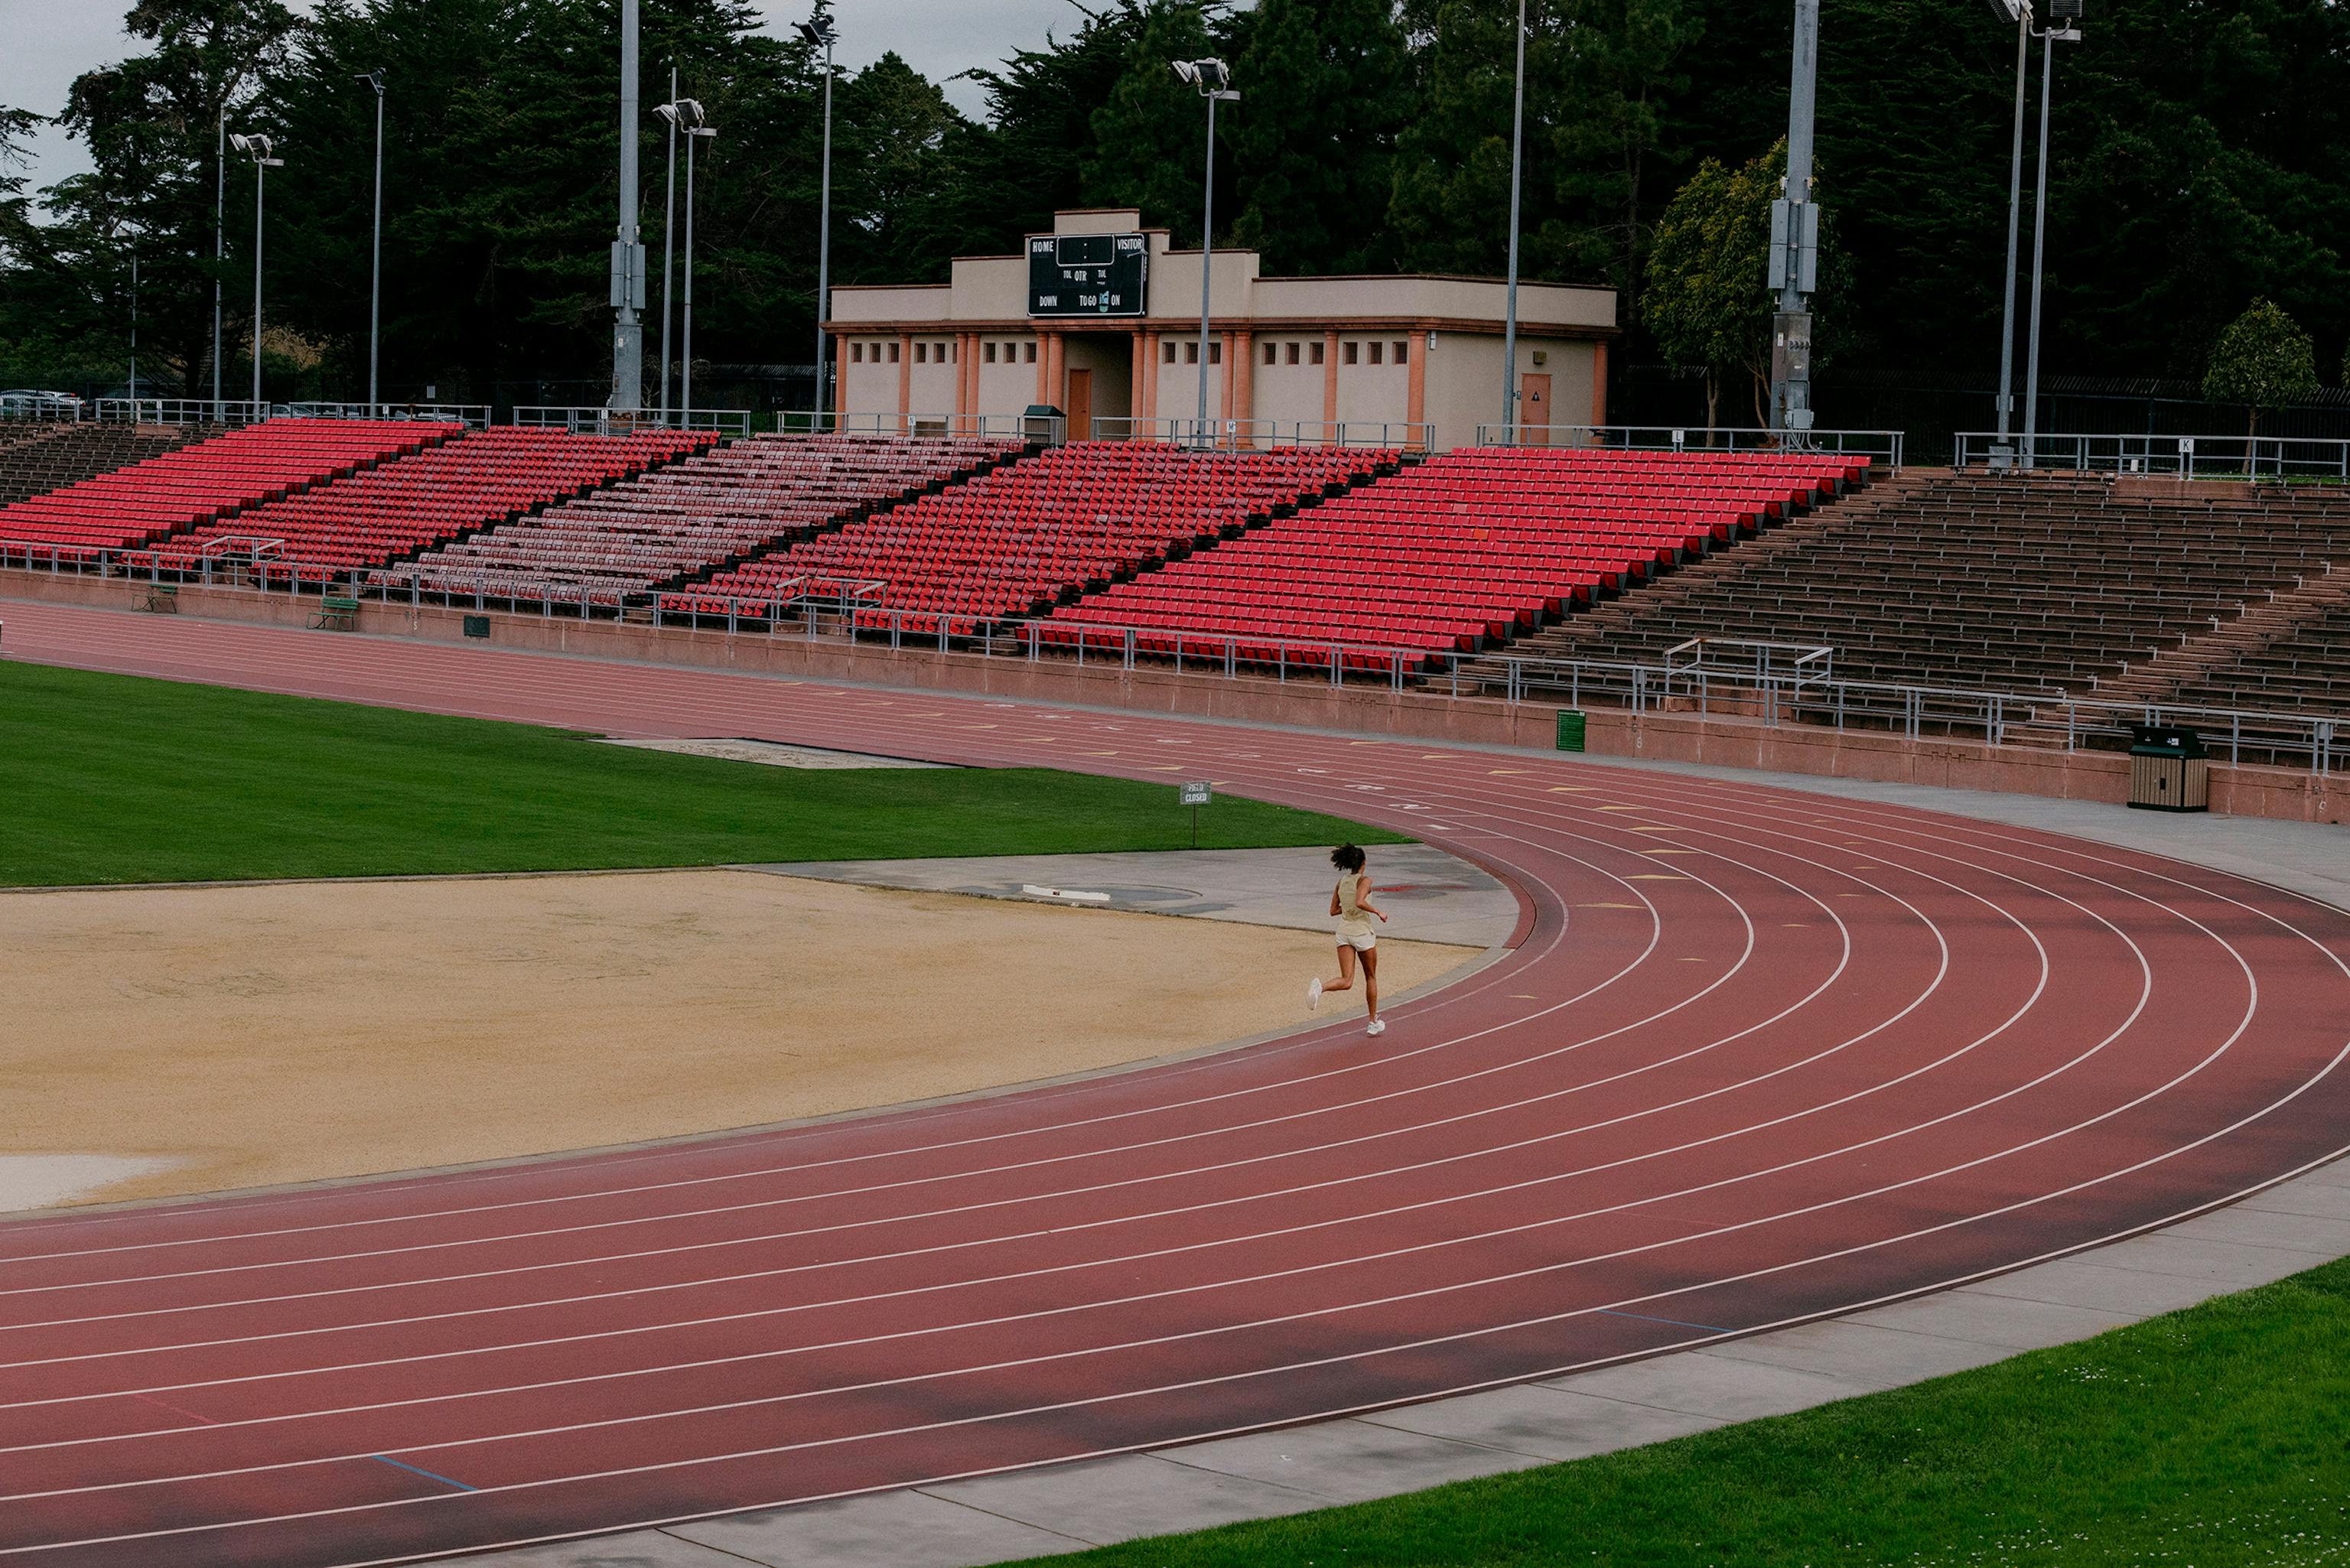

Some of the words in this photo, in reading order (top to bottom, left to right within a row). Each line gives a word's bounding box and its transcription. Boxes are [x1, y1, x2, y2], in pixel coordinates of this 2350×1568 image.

[1033, 241, 1054, 252] HOME
[1117, 238, 1142, 250] VISITOR
[1040, 295, 1058, 307] DOWN
[1079, 294, 1087, 307] TO
[1088, 294, 1097, 307] GO
[1111, 294, 1121, 306] ON
[2182, 440, 2190, 451] K
[1186, 793, 1207, 802] CLOSED
